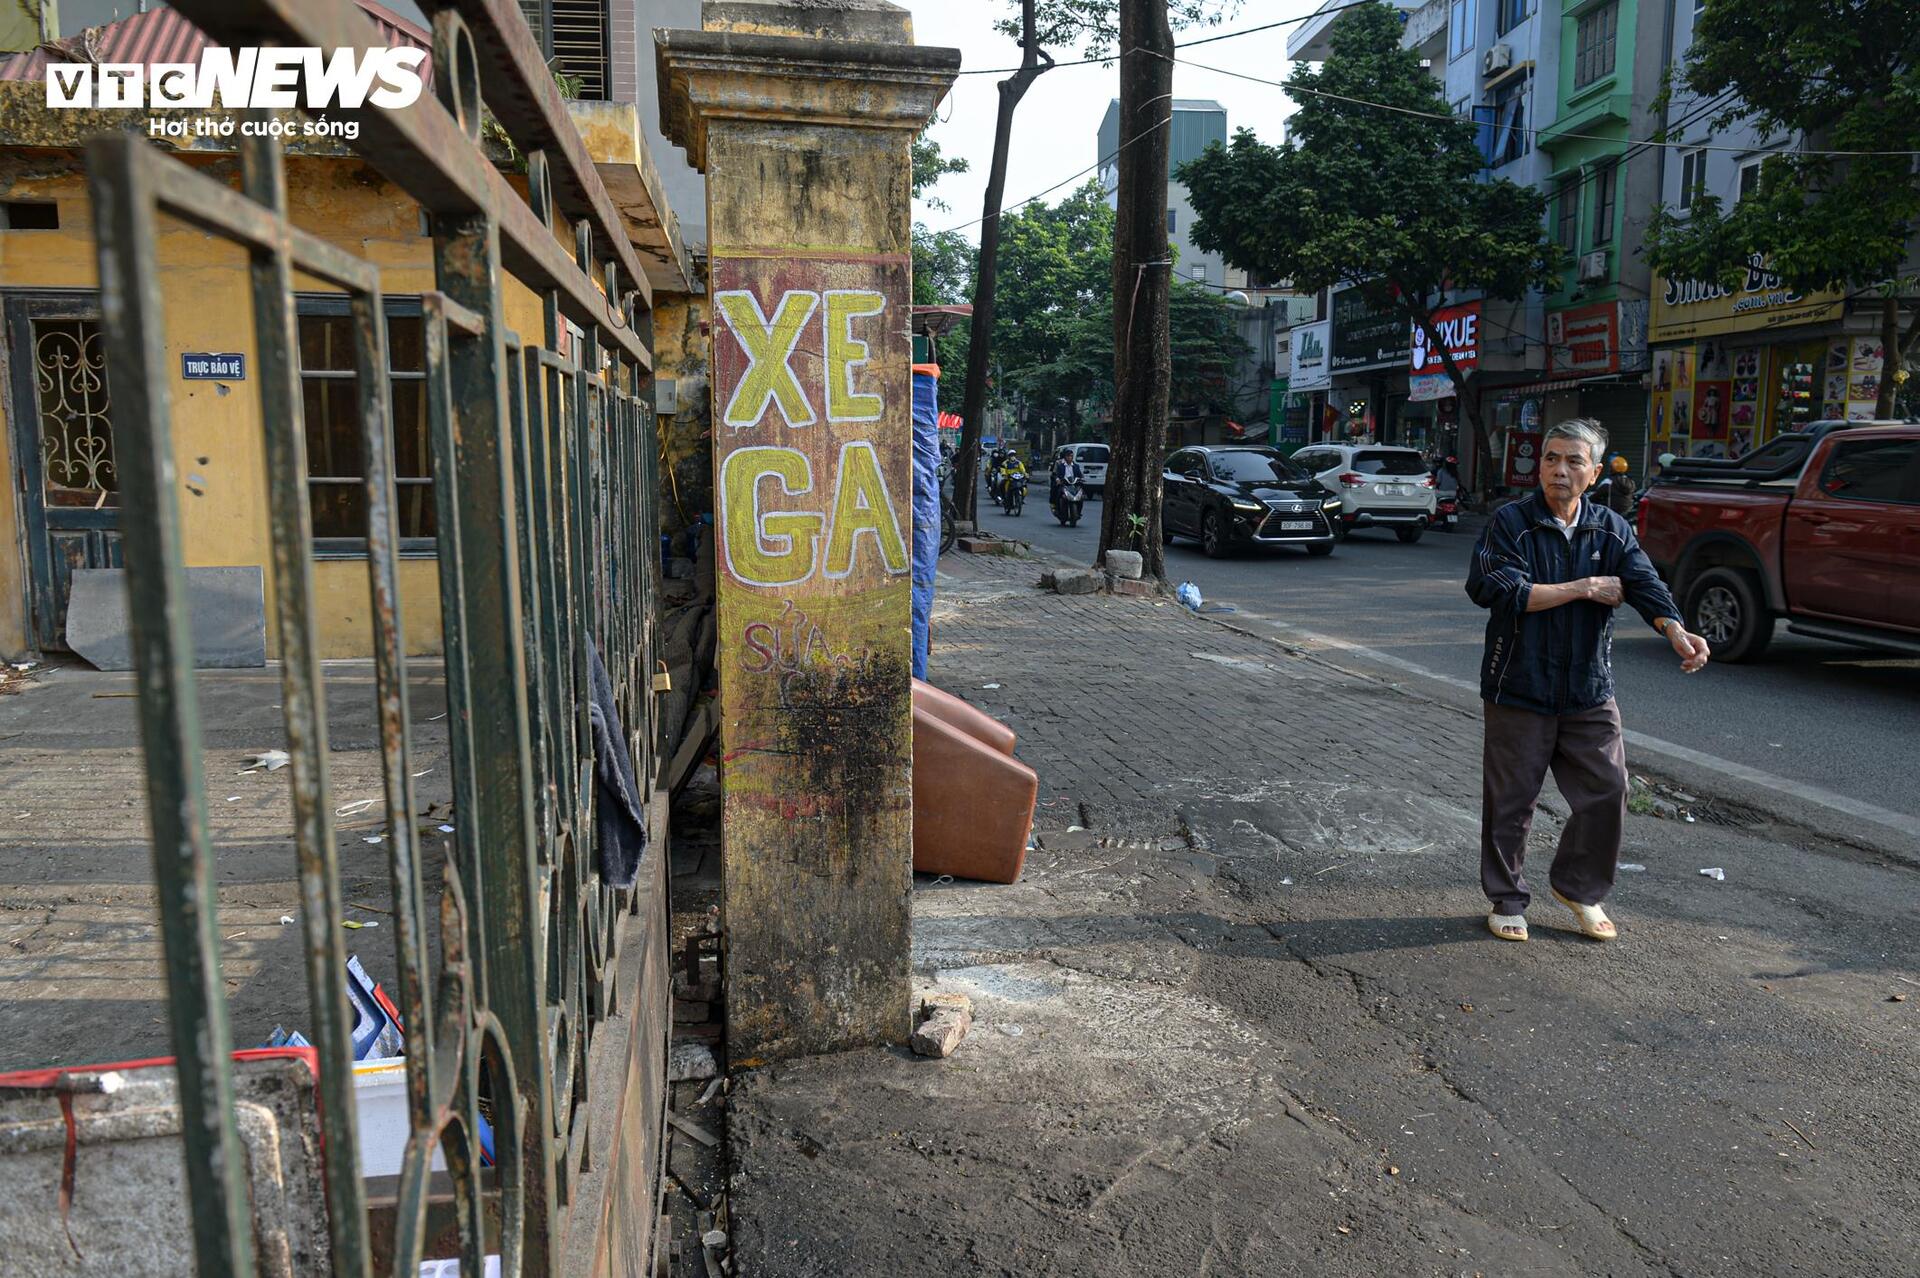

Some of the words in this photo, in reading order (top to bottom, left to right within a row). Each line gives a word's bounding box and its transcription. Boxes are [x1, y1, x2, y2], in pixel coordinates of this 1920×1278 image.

[187, 360, 209, 376] TRỰC
[210, 357, 228, 374] BẢO
[229, 360, 241, 377] VỆ
[714, 290, 887, 428] XE
[720, 441, 909, 587] GA
